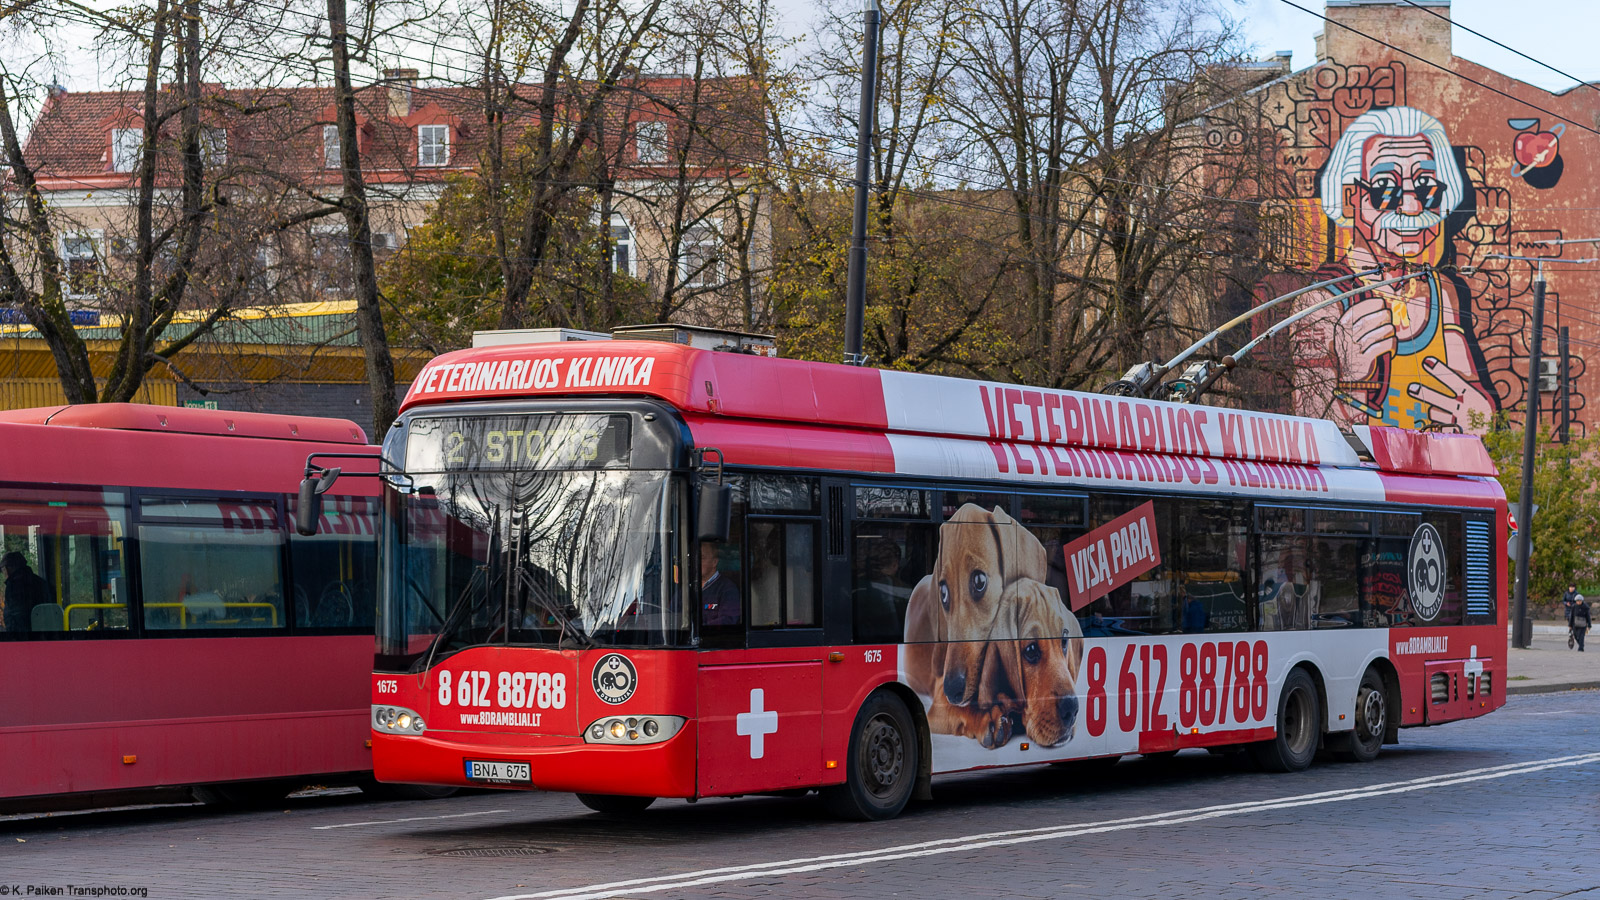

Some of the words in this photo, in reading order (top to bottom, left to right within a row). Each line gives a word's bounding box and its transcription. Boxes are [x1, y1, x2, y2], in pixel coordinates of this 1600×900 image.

[413, 358, 564, 394] VETERINARIJOS
[565, 357, 655, 387] KLINIKA
[448, 432, 464, 462] 2
[979, 385, 1219, 484] VETERINARIJOS
[1218, 412, 1329, 492] KLINIKA
[1071, 539, 1113, 586] VISĄ
[1110, 516, 1155, 562] PARĄ
[863, 649, 882, 663] 1675
[376, 680, 398, 694] 1675
[438, 670, 451, 705] 8
[457, 670, 491, 707] 612
[498, 672, 566, 709] 88788
[600, 689, 632, 703] DRAMBLIAI
[1086, 646, 1107, 737] 8
[1117, 643, 1168, 732] 612
[1180, 640, 1269, 726] 88788
[460, 711, 542, 727] www.8DRAMBLIAI.LT
[474, 763, 498, 777] BNA
[506, 765, 527, 778] 675
